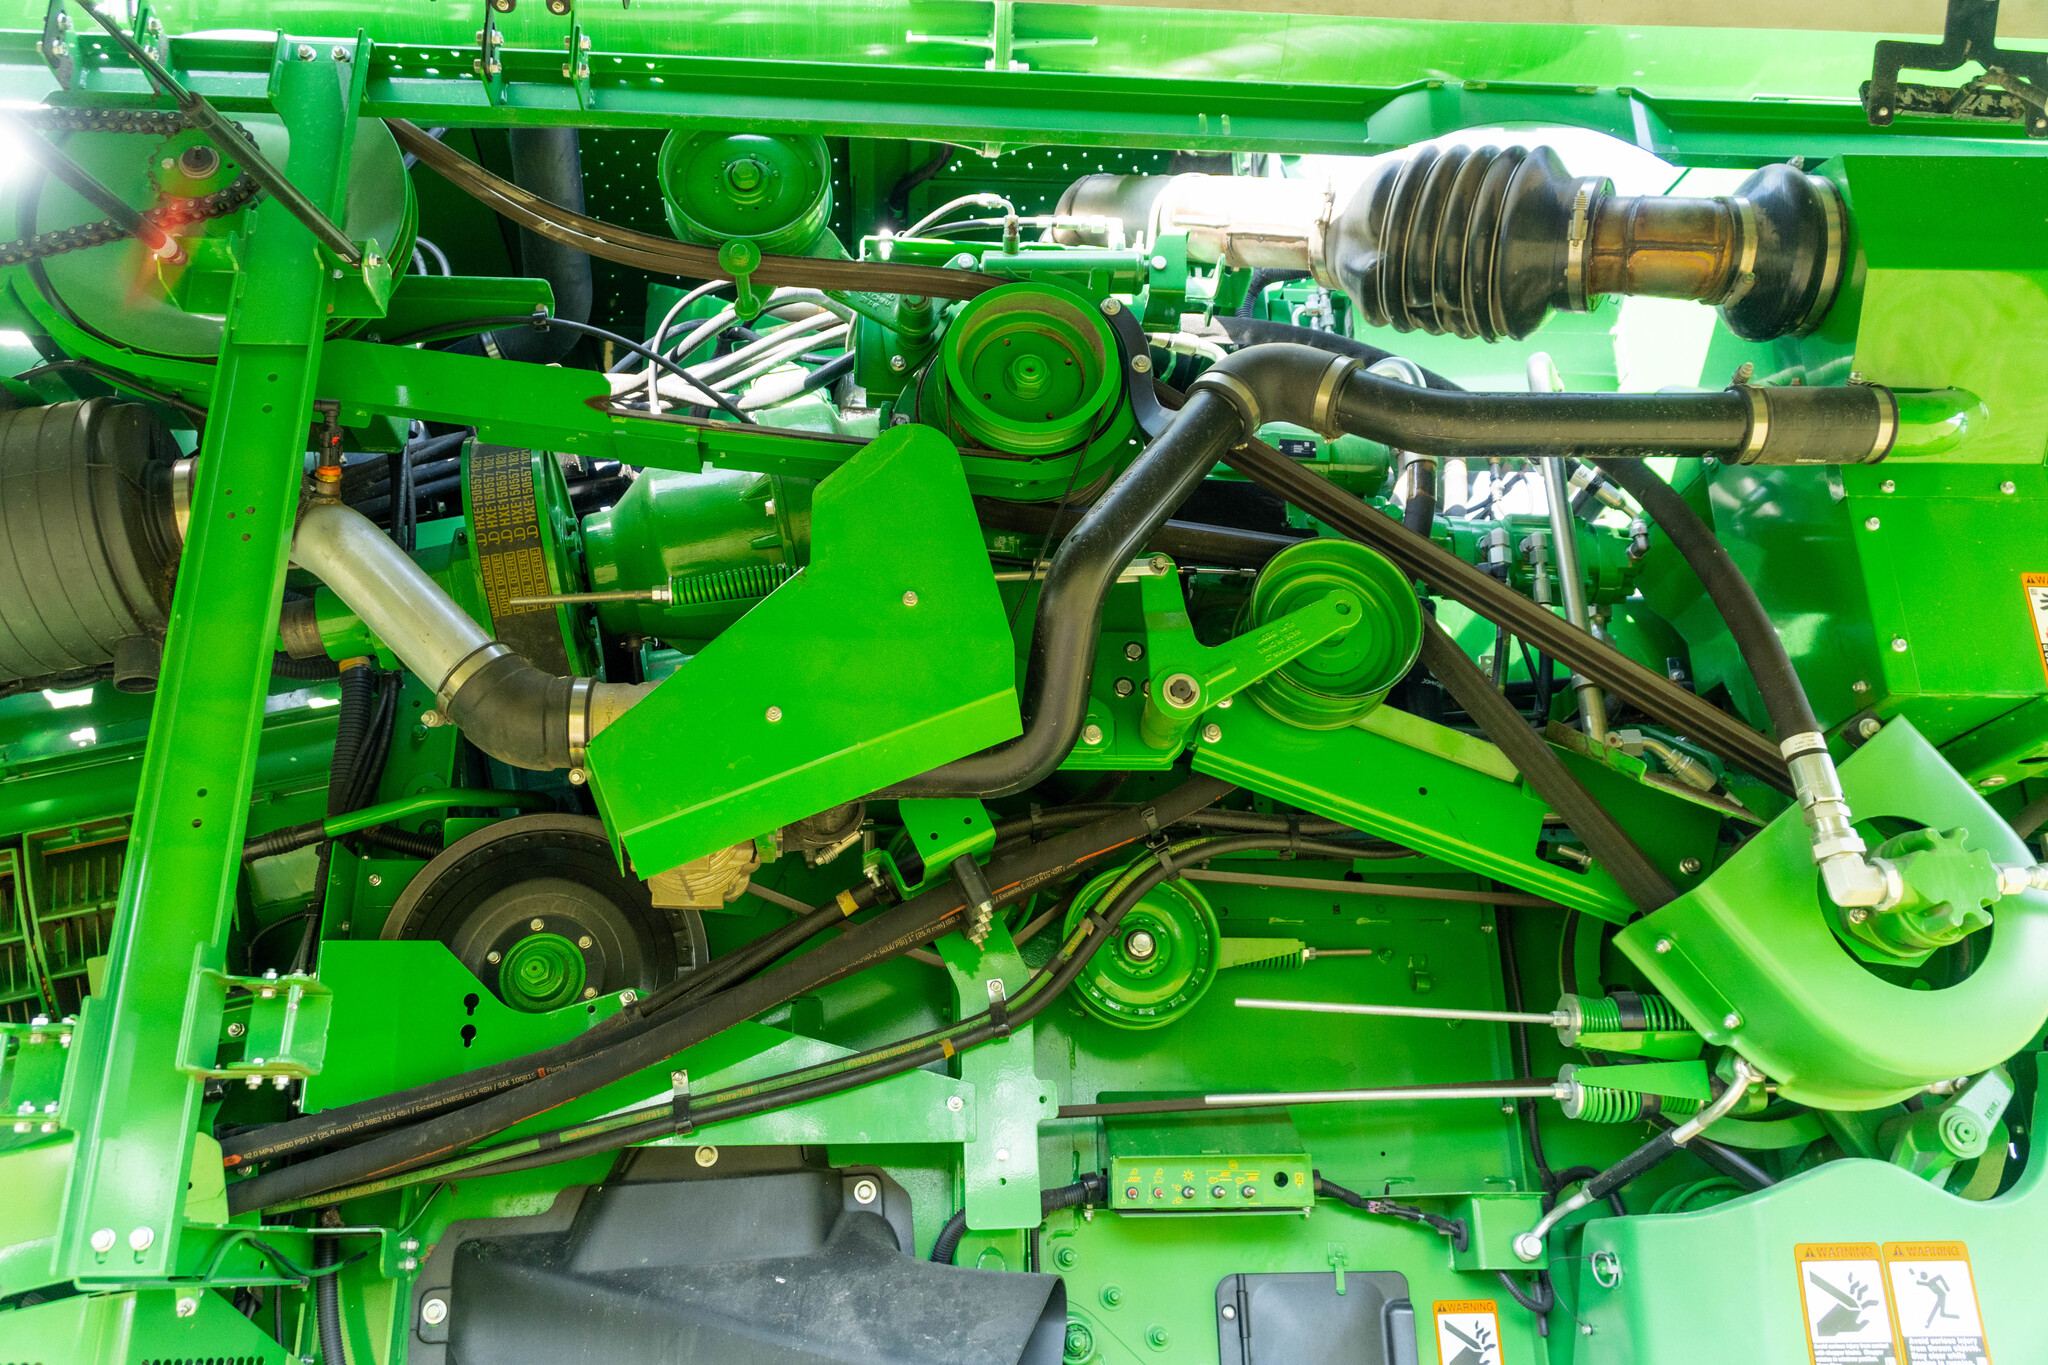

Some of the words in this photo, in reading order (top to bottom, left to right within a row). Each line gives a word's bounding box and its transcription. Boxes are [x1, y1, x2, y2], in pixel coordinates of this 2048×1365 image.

[471, 457, 482, 473] 1821
[483, 455, 494, 471] 1821
[496, 453, 506, 469] 1821
[508, 451, 519, 467] 1821
[521, 449, 531, 464] 1821
[471, 474, 485, 529] HXE150557
[483, 473, 498, 528] HXE150557
[496, 471, 511, 526] HXE150557
[508, 469, 523, 524] HXE150557
[521, 467, 536, 522] HXE150557
[493, 555, 504, 586] DEERE
[506, 553, 518, 584] DEERE
[519, 551, 531, 582] DEERE
[531, 549, 543, 579] DEERE
[500, 590, 511, 614] JOHN
[512, 587, 524, 613] JHN
[525, 585, 537, 610] JHN
[1170, 838, 1207, 853] Dura-Tuff
[997, 885, 1021, 900] Exceeds
[1104, 873, 1132, 904] GH781-8
[944, 916, 956, 925] ISO
[716, 1086, 754, 1102] Dura-Tuff
[856, 1055, 871, 1066] 345
[872, 1051, 888, 1061] BAR
[888, 1044, 911, 1056] (5000
[911, 1039, 926, 1050] PSI)
[243, 1151, 258, 1160] 42.0
[258, 1146, 273, 1155] MPa
[352, 1121, 364, 1129] ISO
[364, 1116, 382, 1126] 3862
[382, 1112, 396, 1121] R15
[415, 1098, 442, 1112] Exceeds
[442, 1092, 464, 1104] EN856
[464, 1088, 478, 1098] R15
[478, 1084, 492, 1093] 4SH
[497, 1079, 510, 1088] SAE
[545, 1062, 565, 1073] Flame
[313, 1194, 329, 1204] 345
[329, 1190, 347, 1201] BAR
[347, 1184, 370, 1196] (5000
[634, 1106, 669, 1122] GH781-8
[1816, 1247, 1874, 1258] WARNING
[1906, 1246, 1960, 1257] WARNING
[1448, 1302, 1494, 1312] WARNING
[1909, 1337, 1929, 1345] Avoid
[1957, 1337, 1978, 1346] injury
[1911, 1353, 1927, 1361] Stay
[1946, 1352, 1967, 1360] while
